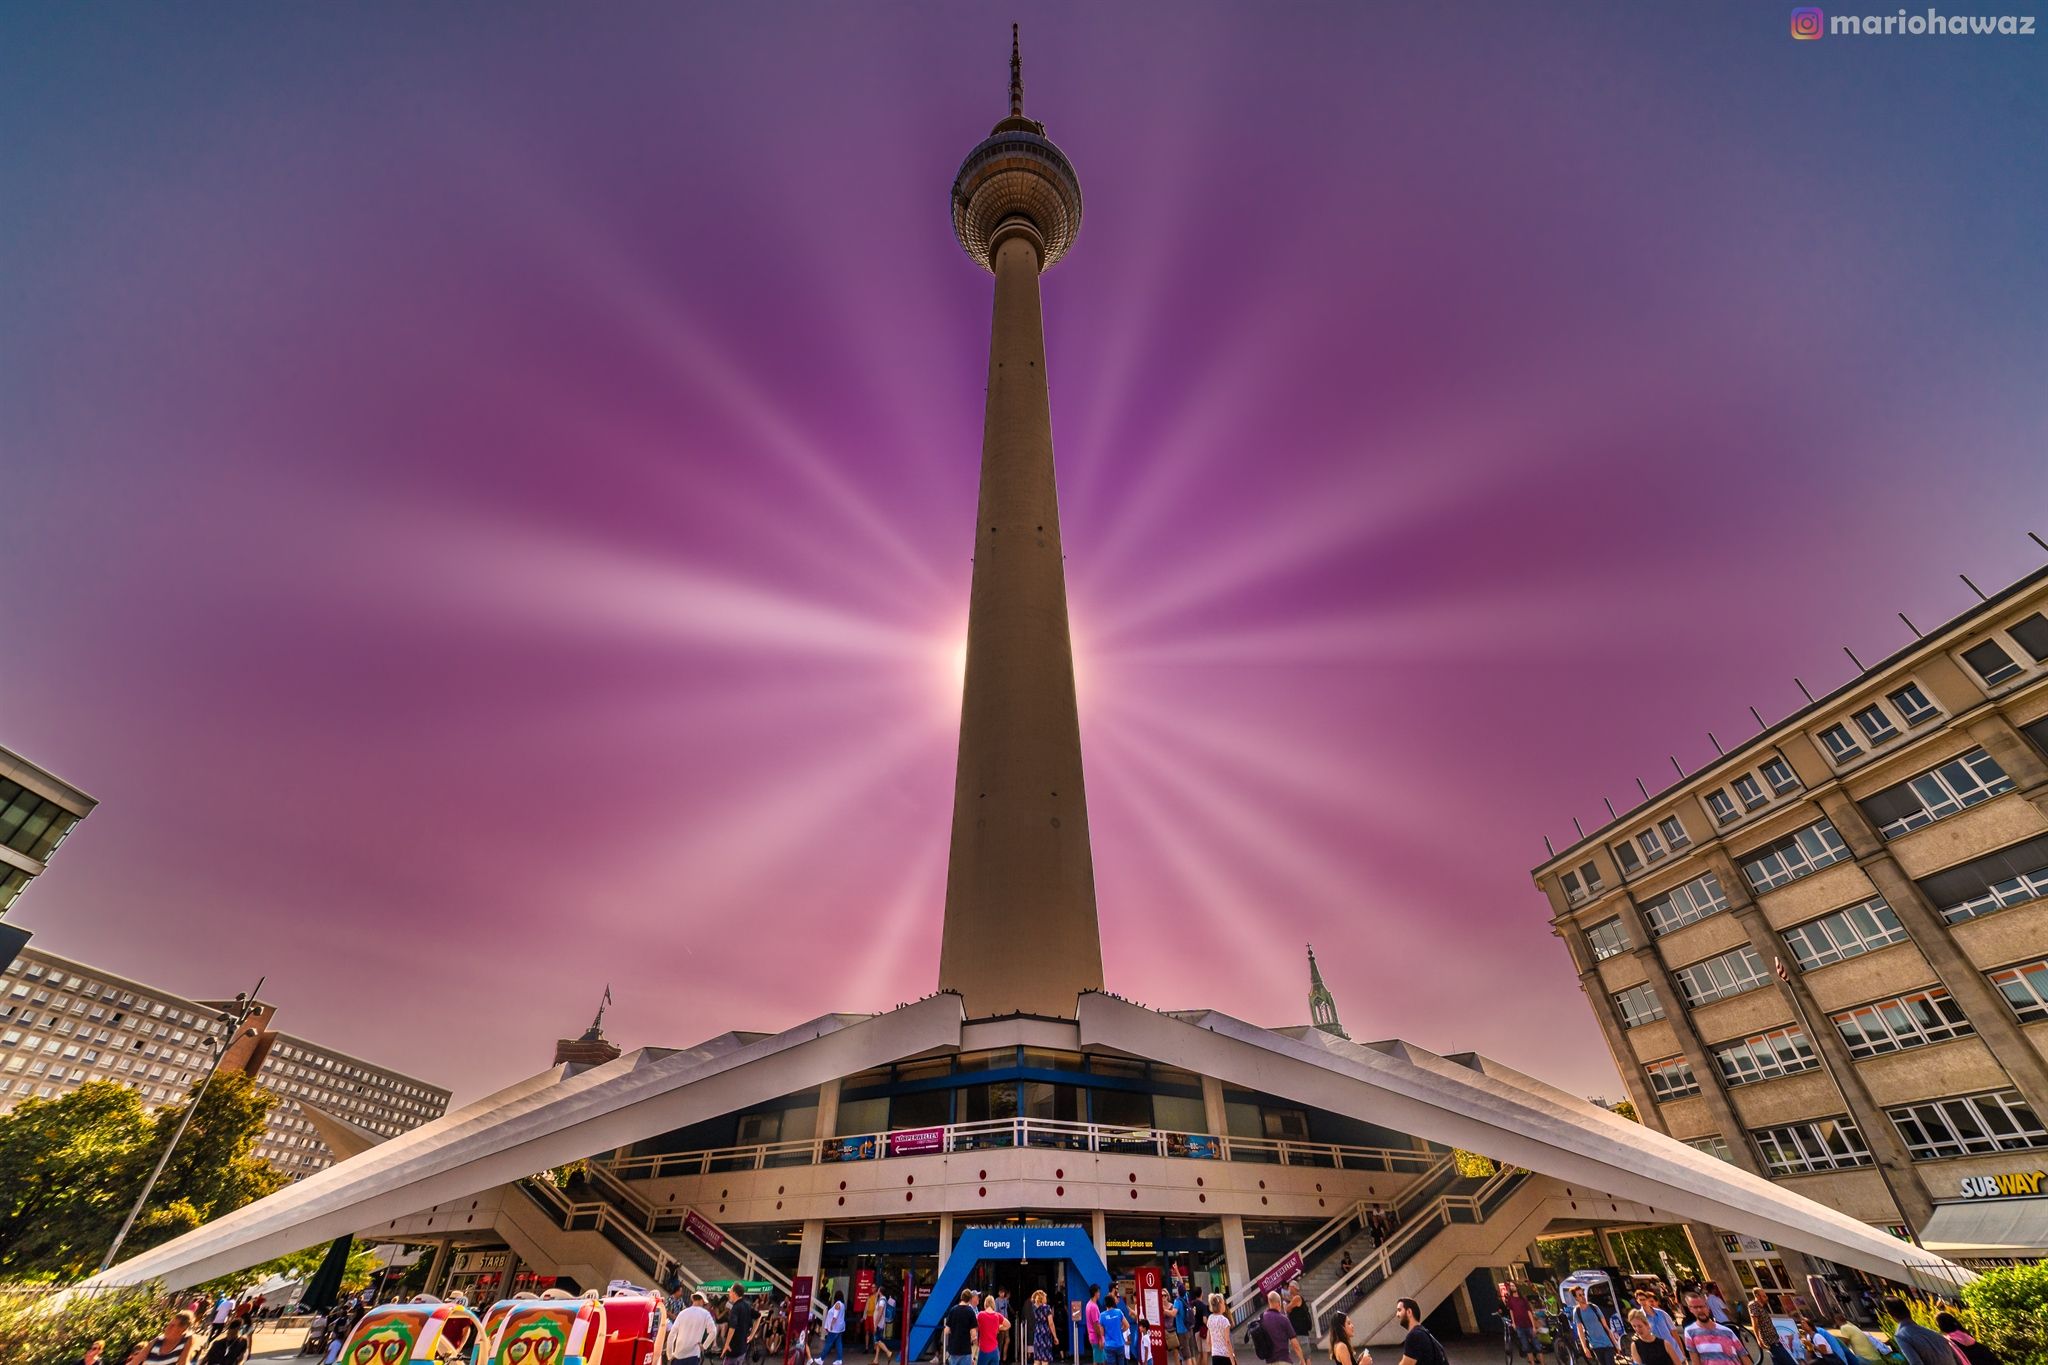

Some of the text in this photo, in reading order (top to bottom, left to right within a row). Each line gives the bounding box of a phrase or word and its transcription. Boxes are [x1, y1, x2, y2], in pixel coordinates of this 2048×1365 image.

[1960, 1170, 2047, 1198] SUBWAY
[983, 1240, 1011, 1249] Eingang
[1036, 1239, 1065, 1247] Entrance
